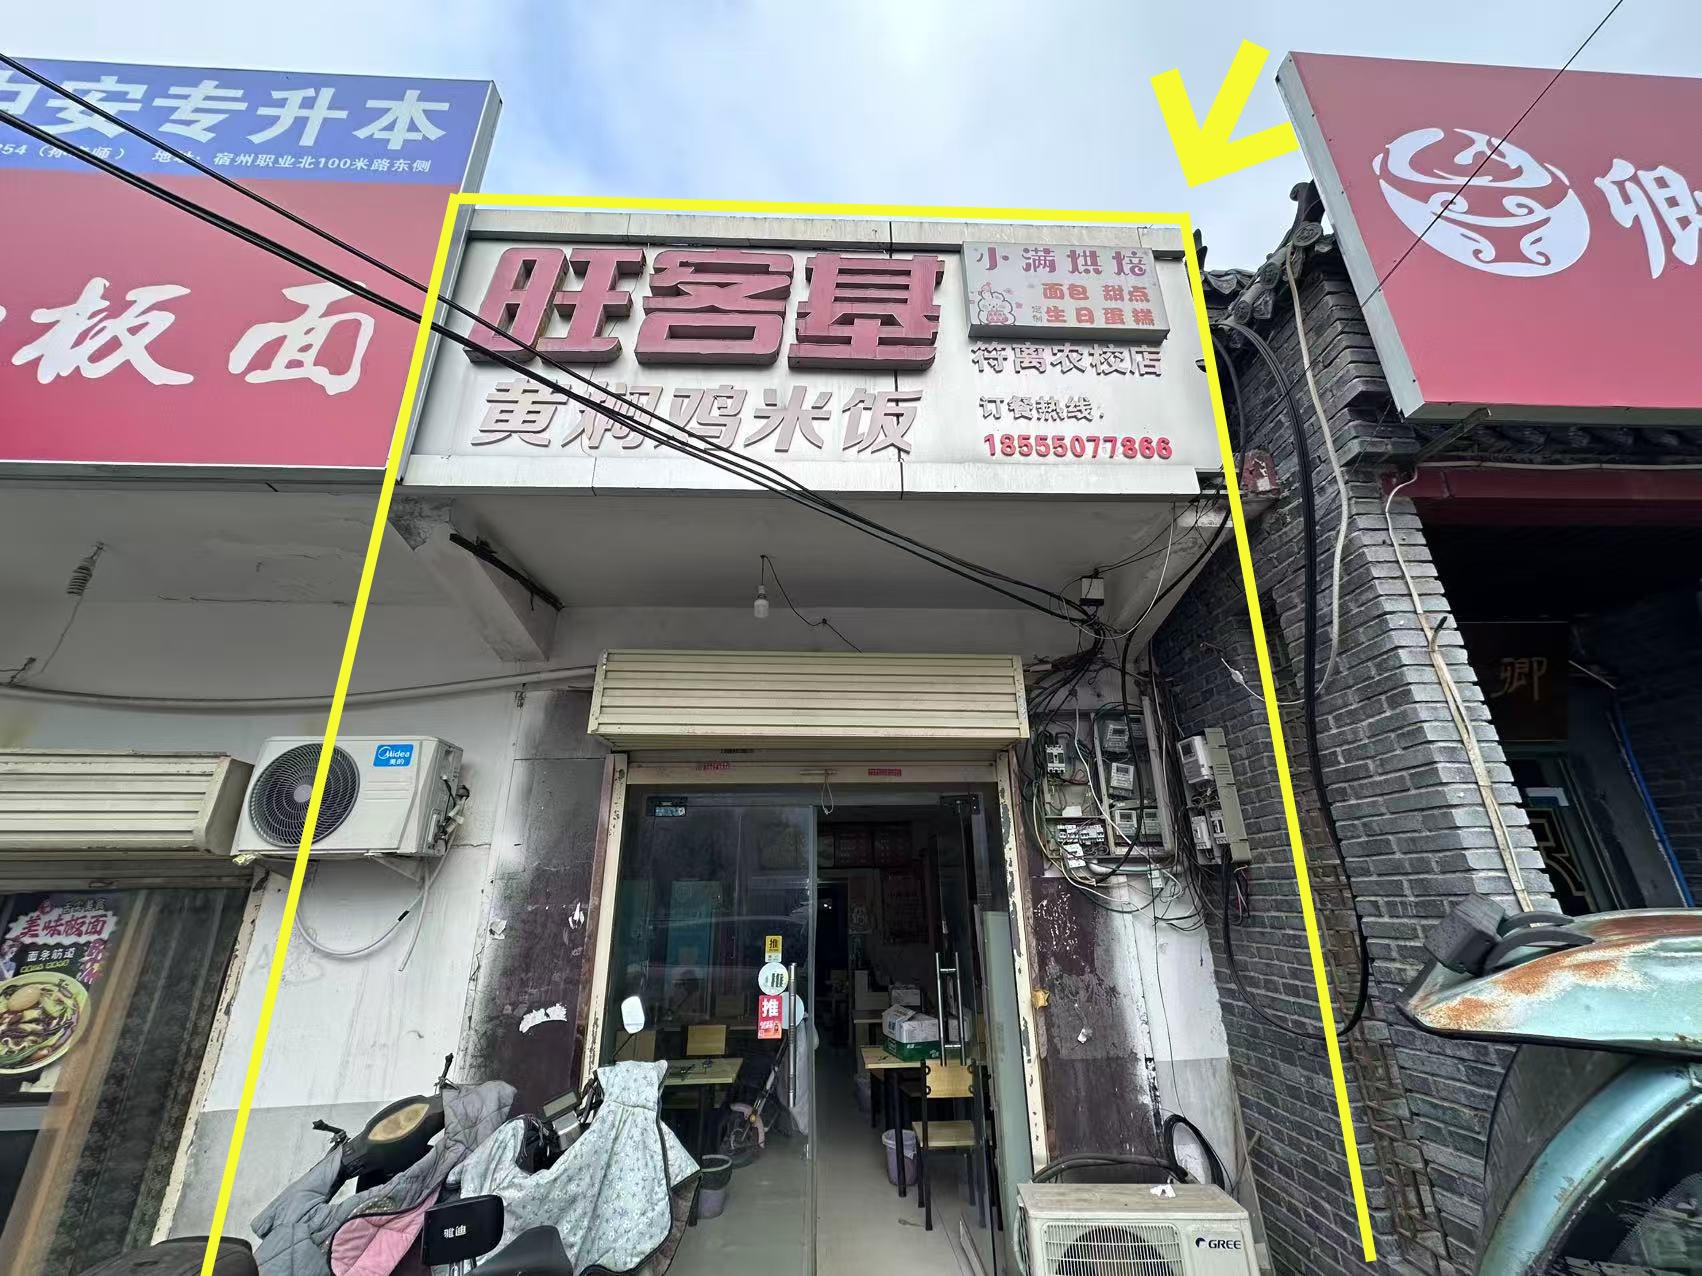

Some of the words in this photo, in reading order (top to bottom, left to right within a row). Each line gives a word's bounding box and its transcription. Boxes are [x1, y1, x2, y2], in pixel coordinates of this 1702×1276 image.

[213, 152, 431, 173] 宿州职业北100米路东侧
[976, 246, 1146, 277] 小满烘焙
[1042, 282, 1090, 300] 面包
[1101, 284, 1151, 303] 甜点
[463, 246, 946, 371] 旺客基
[1044, 304, 1156, 327] 生日蛋糕
[0, 276, 375, 396] 板面
[471, 378, 922, 454] 黄焖鸡米饭
[984, 433, 1173, 460] 18555077866
[378, 746, 411, 760] Midea
[761, 998, 780, 1018] 推
[1207, 1238, 1242, 1251] GREE
